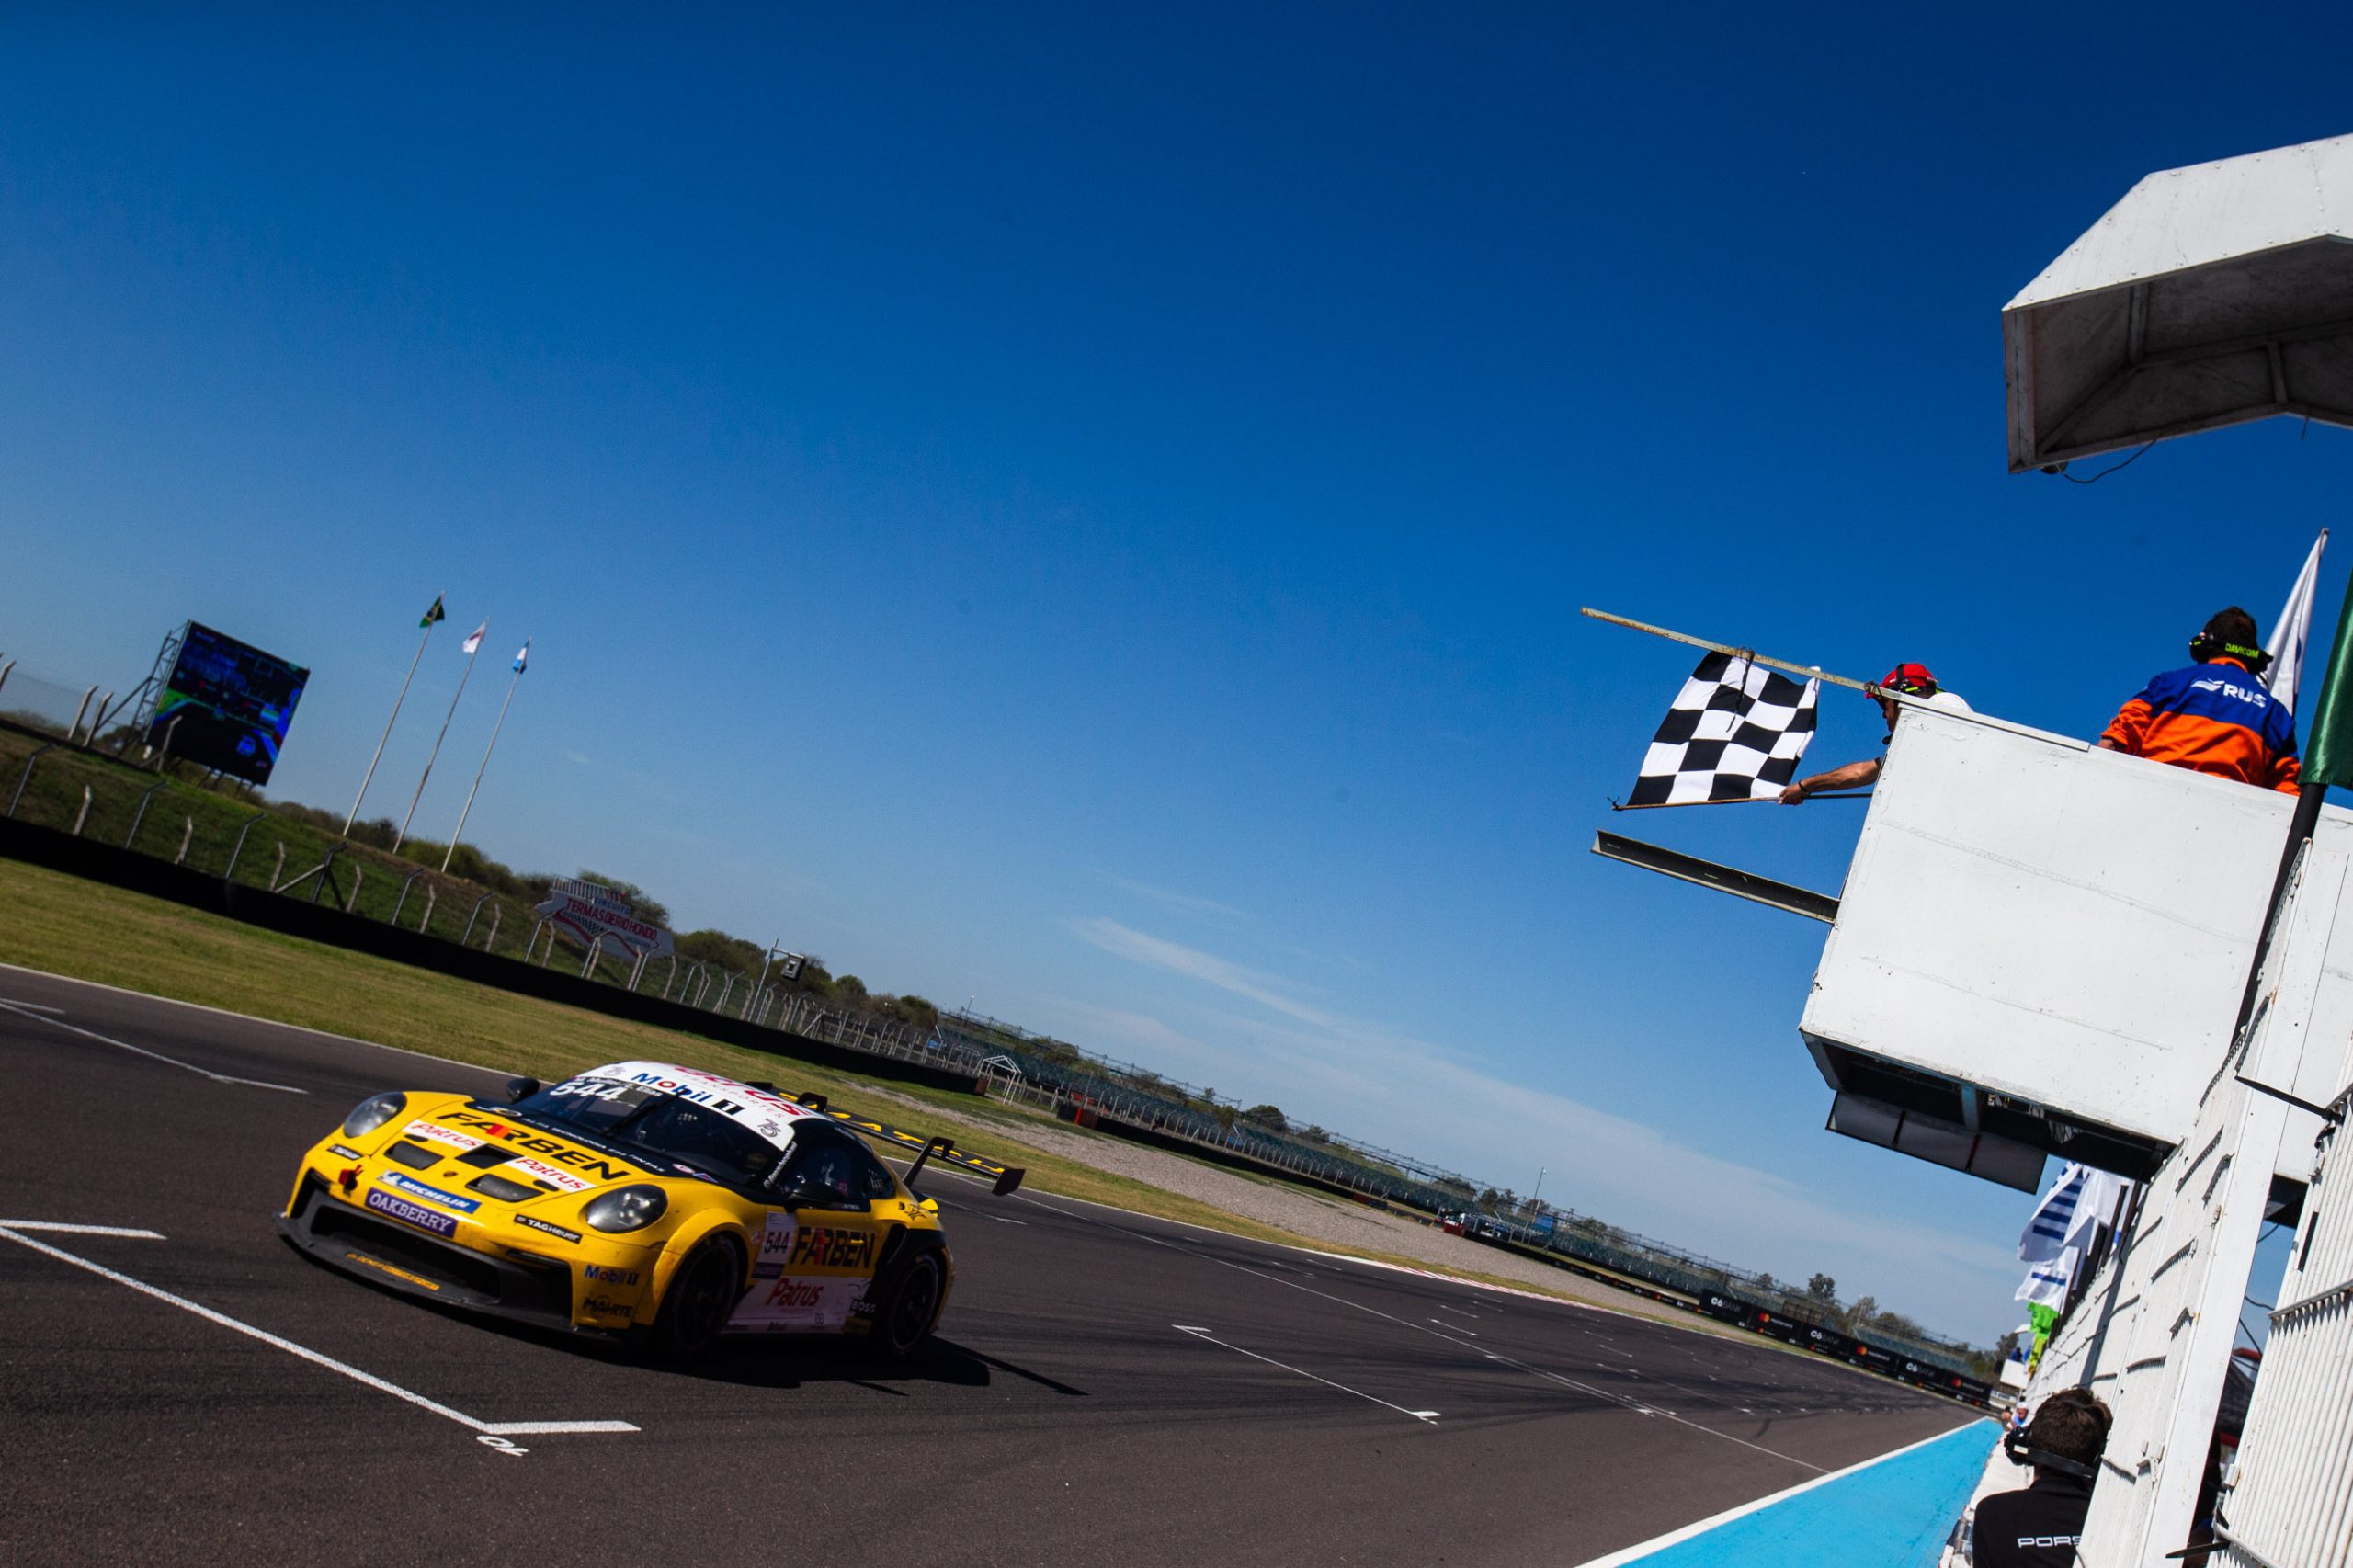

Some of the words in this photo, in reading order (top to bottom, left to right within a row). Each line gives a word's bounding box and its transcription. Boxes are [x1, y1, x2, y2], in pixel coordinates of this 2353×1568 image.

[2225, 643, 2259, 659] DAVICOM
[2223, 684, 2267, 708] RUS
[567, 897, 605, 923] TERMAS
[629, 920, 657, 941] HONDO
[550, 1082, 627, 1101] 544
[631, 1072, 713, 1103] Mobil
[414, 1122, 483, 1148] Patrus
[436, 1112, 631, 1180] FARBEN
[516, 1158, 589, 1191] Patrus
[400, 1180, 471, 1210] MICHELIN
[368, 1192, 454, 1233] OAKBERRY
[765, 1231, 790, 1254] 544
[790, 1226, 875, 1269] FARBEN
[585, 1264, 626, 1284] Mobil
[765, 1278, 824, 1307] Patrus
